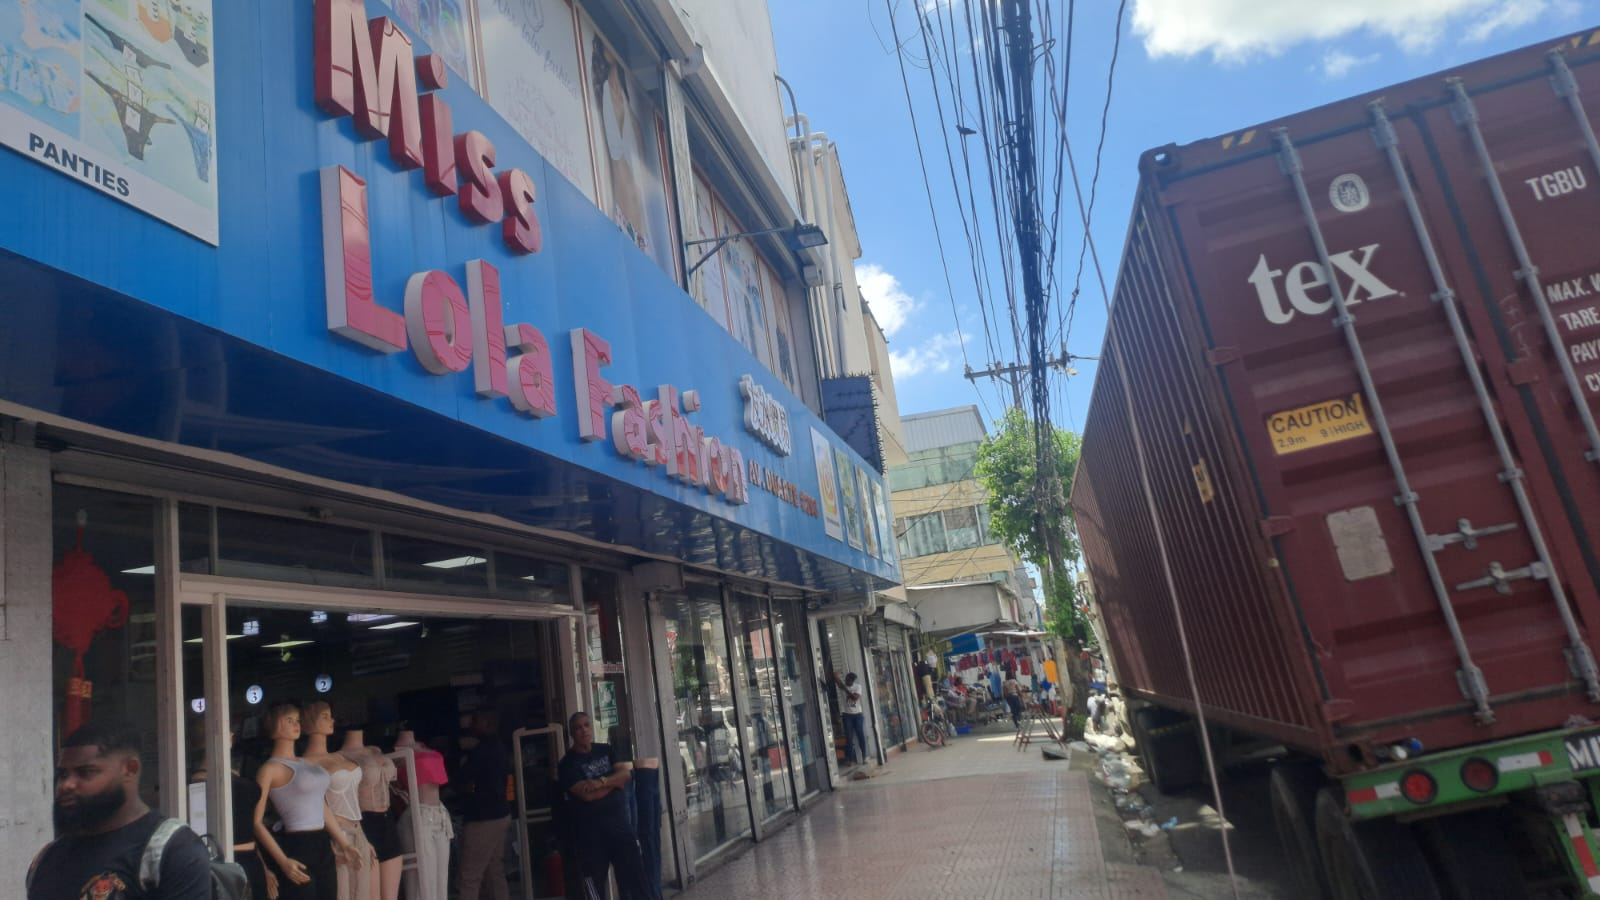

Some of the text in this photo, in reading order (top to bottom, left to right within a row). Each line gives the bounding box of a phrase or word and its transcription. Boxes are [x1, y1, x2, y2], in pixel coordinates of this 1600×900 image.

[314, 0, 542, 255] Miss
[29, 132, 129, 196] PANTIES
[1525, 165, 1587, 201] TGBU
[1247, 243, 1398, 325] tex
[1546, 278, 1591, 303] MAX.
[320, 164, 749, 505] Lola Fashion
[1560, 306, 1600, 331] TARE
[1571, 338, 1600, 364] PAY
[1271, 398, 1360, 433] CAUTION
[1335, 420, 1364, 435] HIGH
